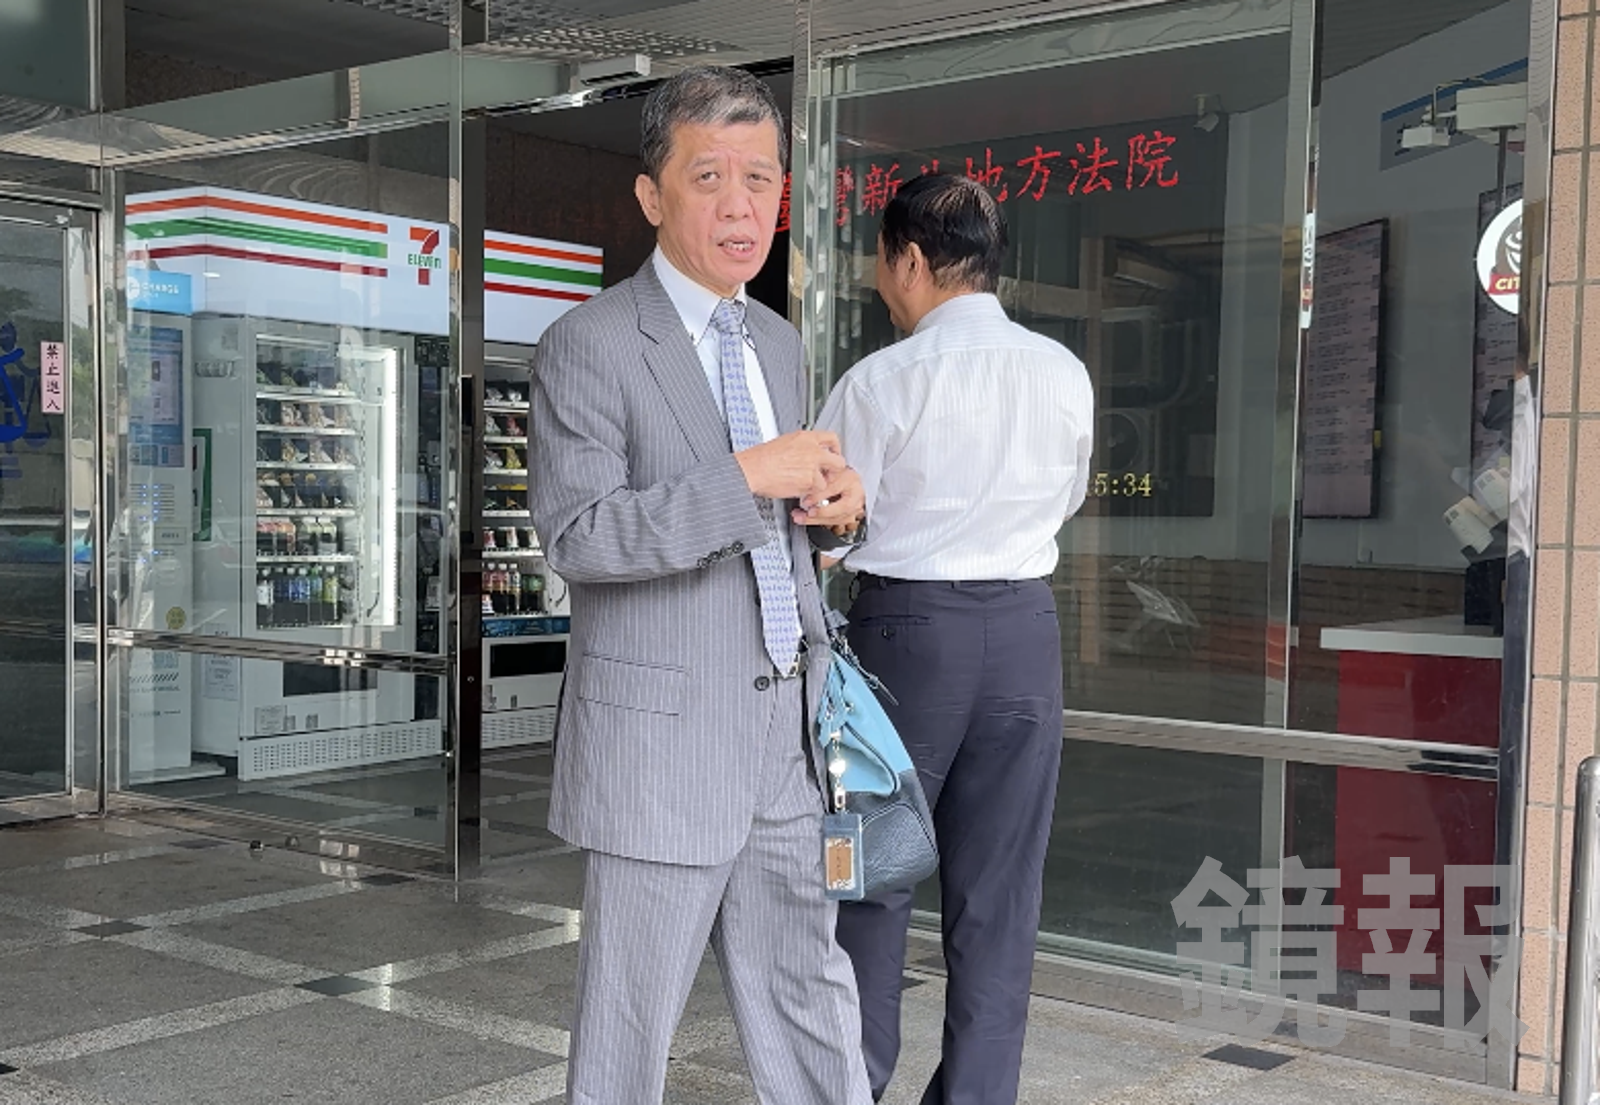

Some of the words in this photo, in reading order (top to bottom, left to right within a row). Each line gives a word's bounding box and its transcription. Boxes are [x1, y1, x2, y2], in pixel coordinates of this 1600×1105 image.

[775, 130, 1179, 233] 新地方法院
[45, 343, 61, 411] 禁止進入
[1086, 472, 1152, 497] 5:34
